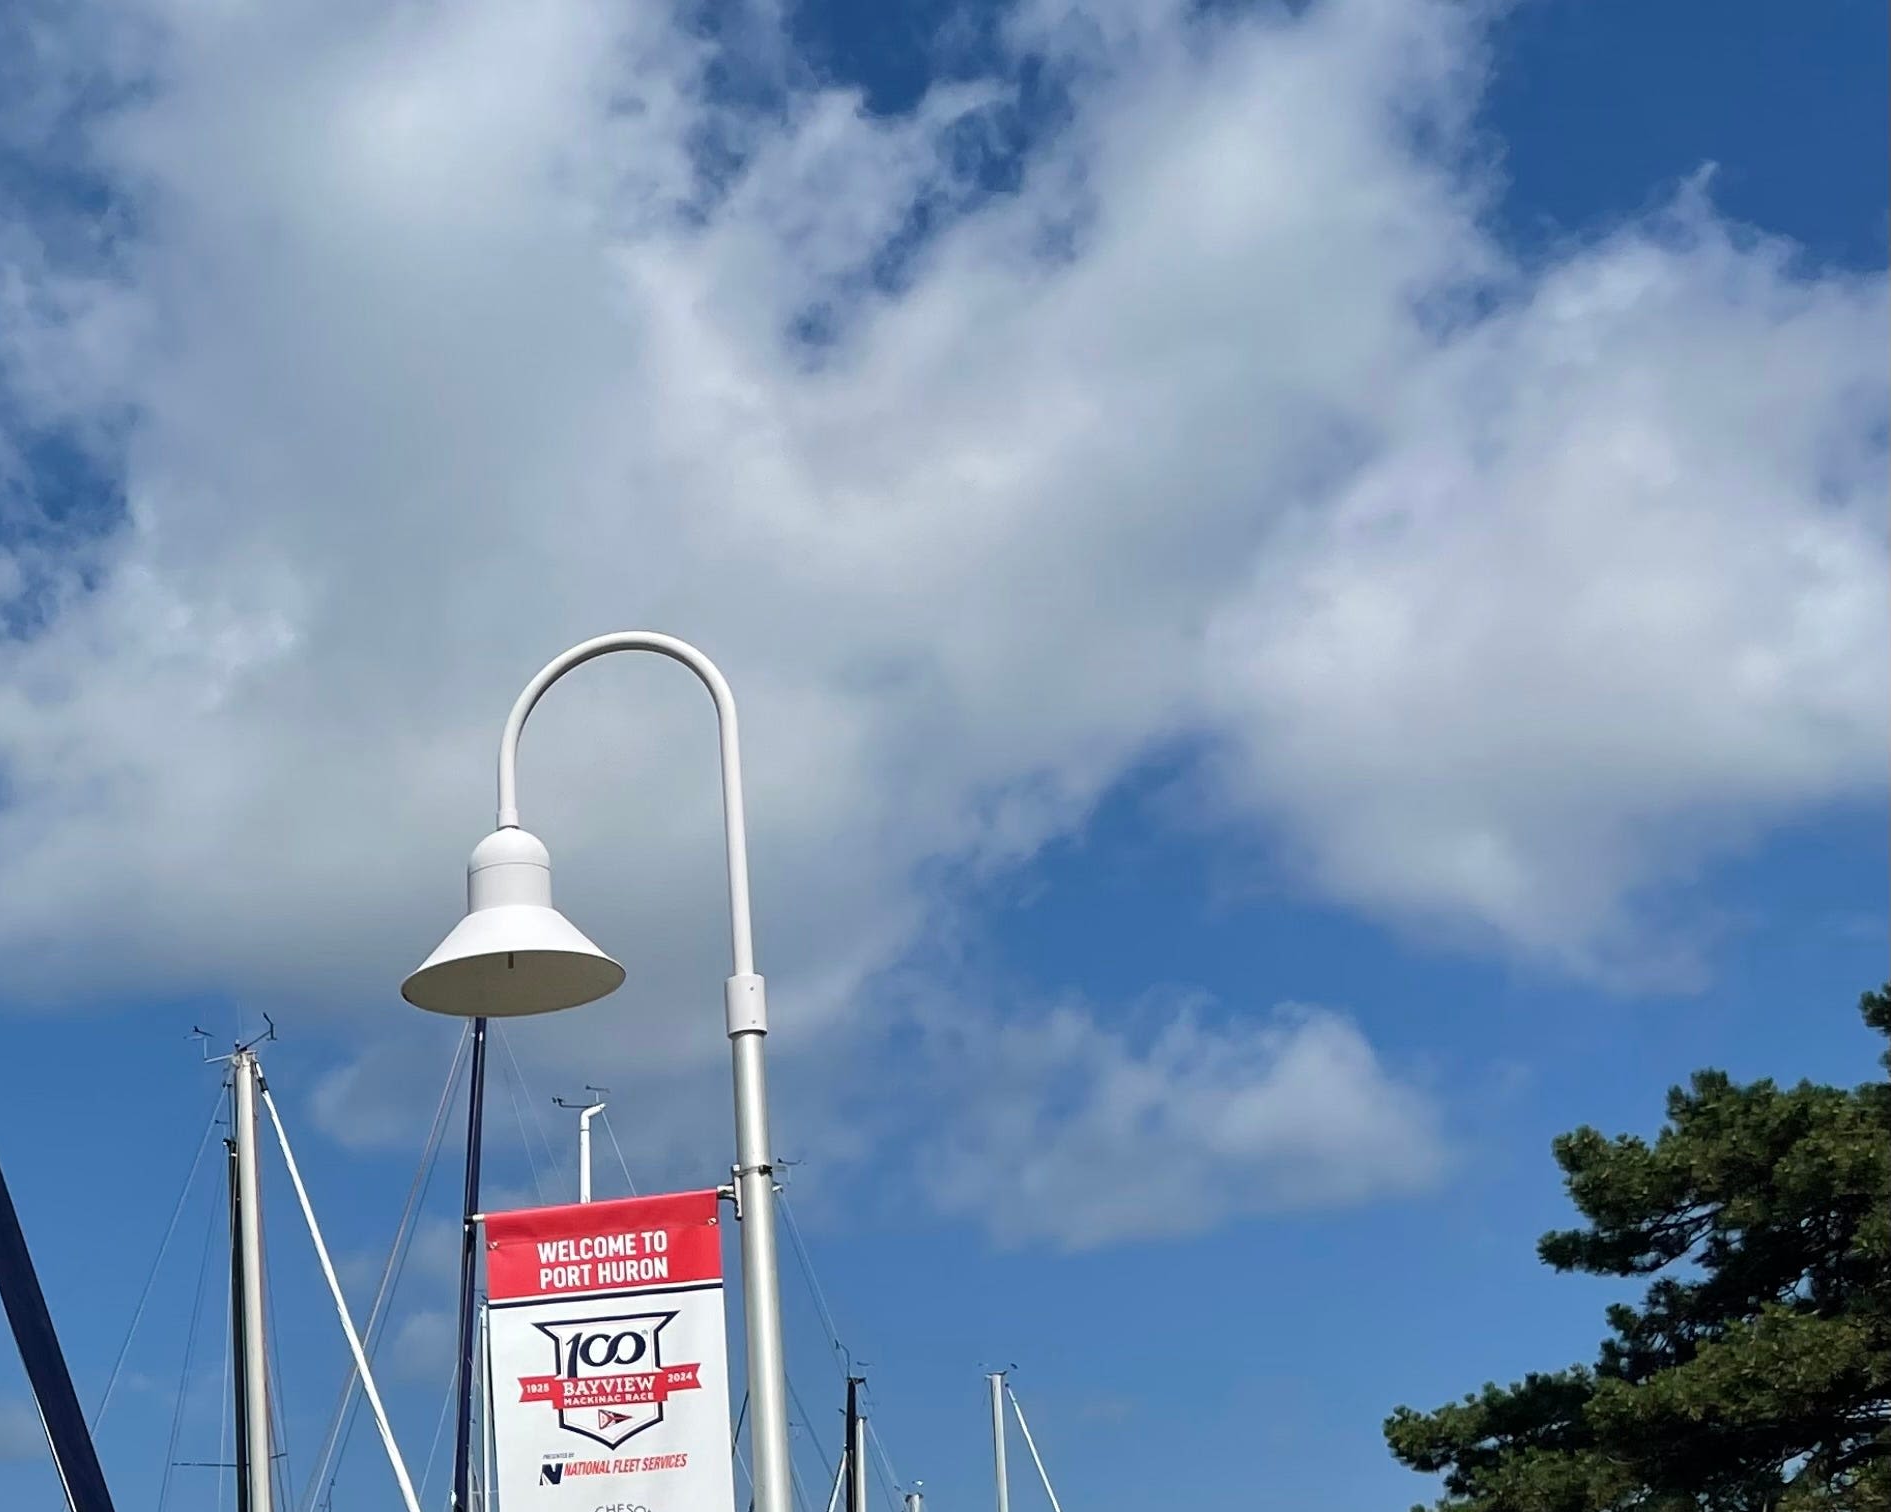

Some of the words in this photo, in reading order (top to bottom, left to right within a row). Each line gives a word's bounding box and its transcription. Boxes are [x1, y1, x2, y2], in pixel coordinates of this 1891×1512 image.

[537, 1233, 636, 1264] WELCOME
[641, 1230, 668, 1253] TO
[539, 1264, 592, 1290] PORT
[597, 1256, 668, 1284] HURON
[562, 1376, 656, 1396] BAYVIEW
[667, 1371, 693, 1383] 2024
[564, 1394, 621, 1407] MACKINAC
[625, 1392, 654, 1402] RACE
[564, 1460, 611, 1477] NATIONAL
[612, 1458, 641, 1474] FLEET
[642, 1453, 688, 1471] SERVICES
